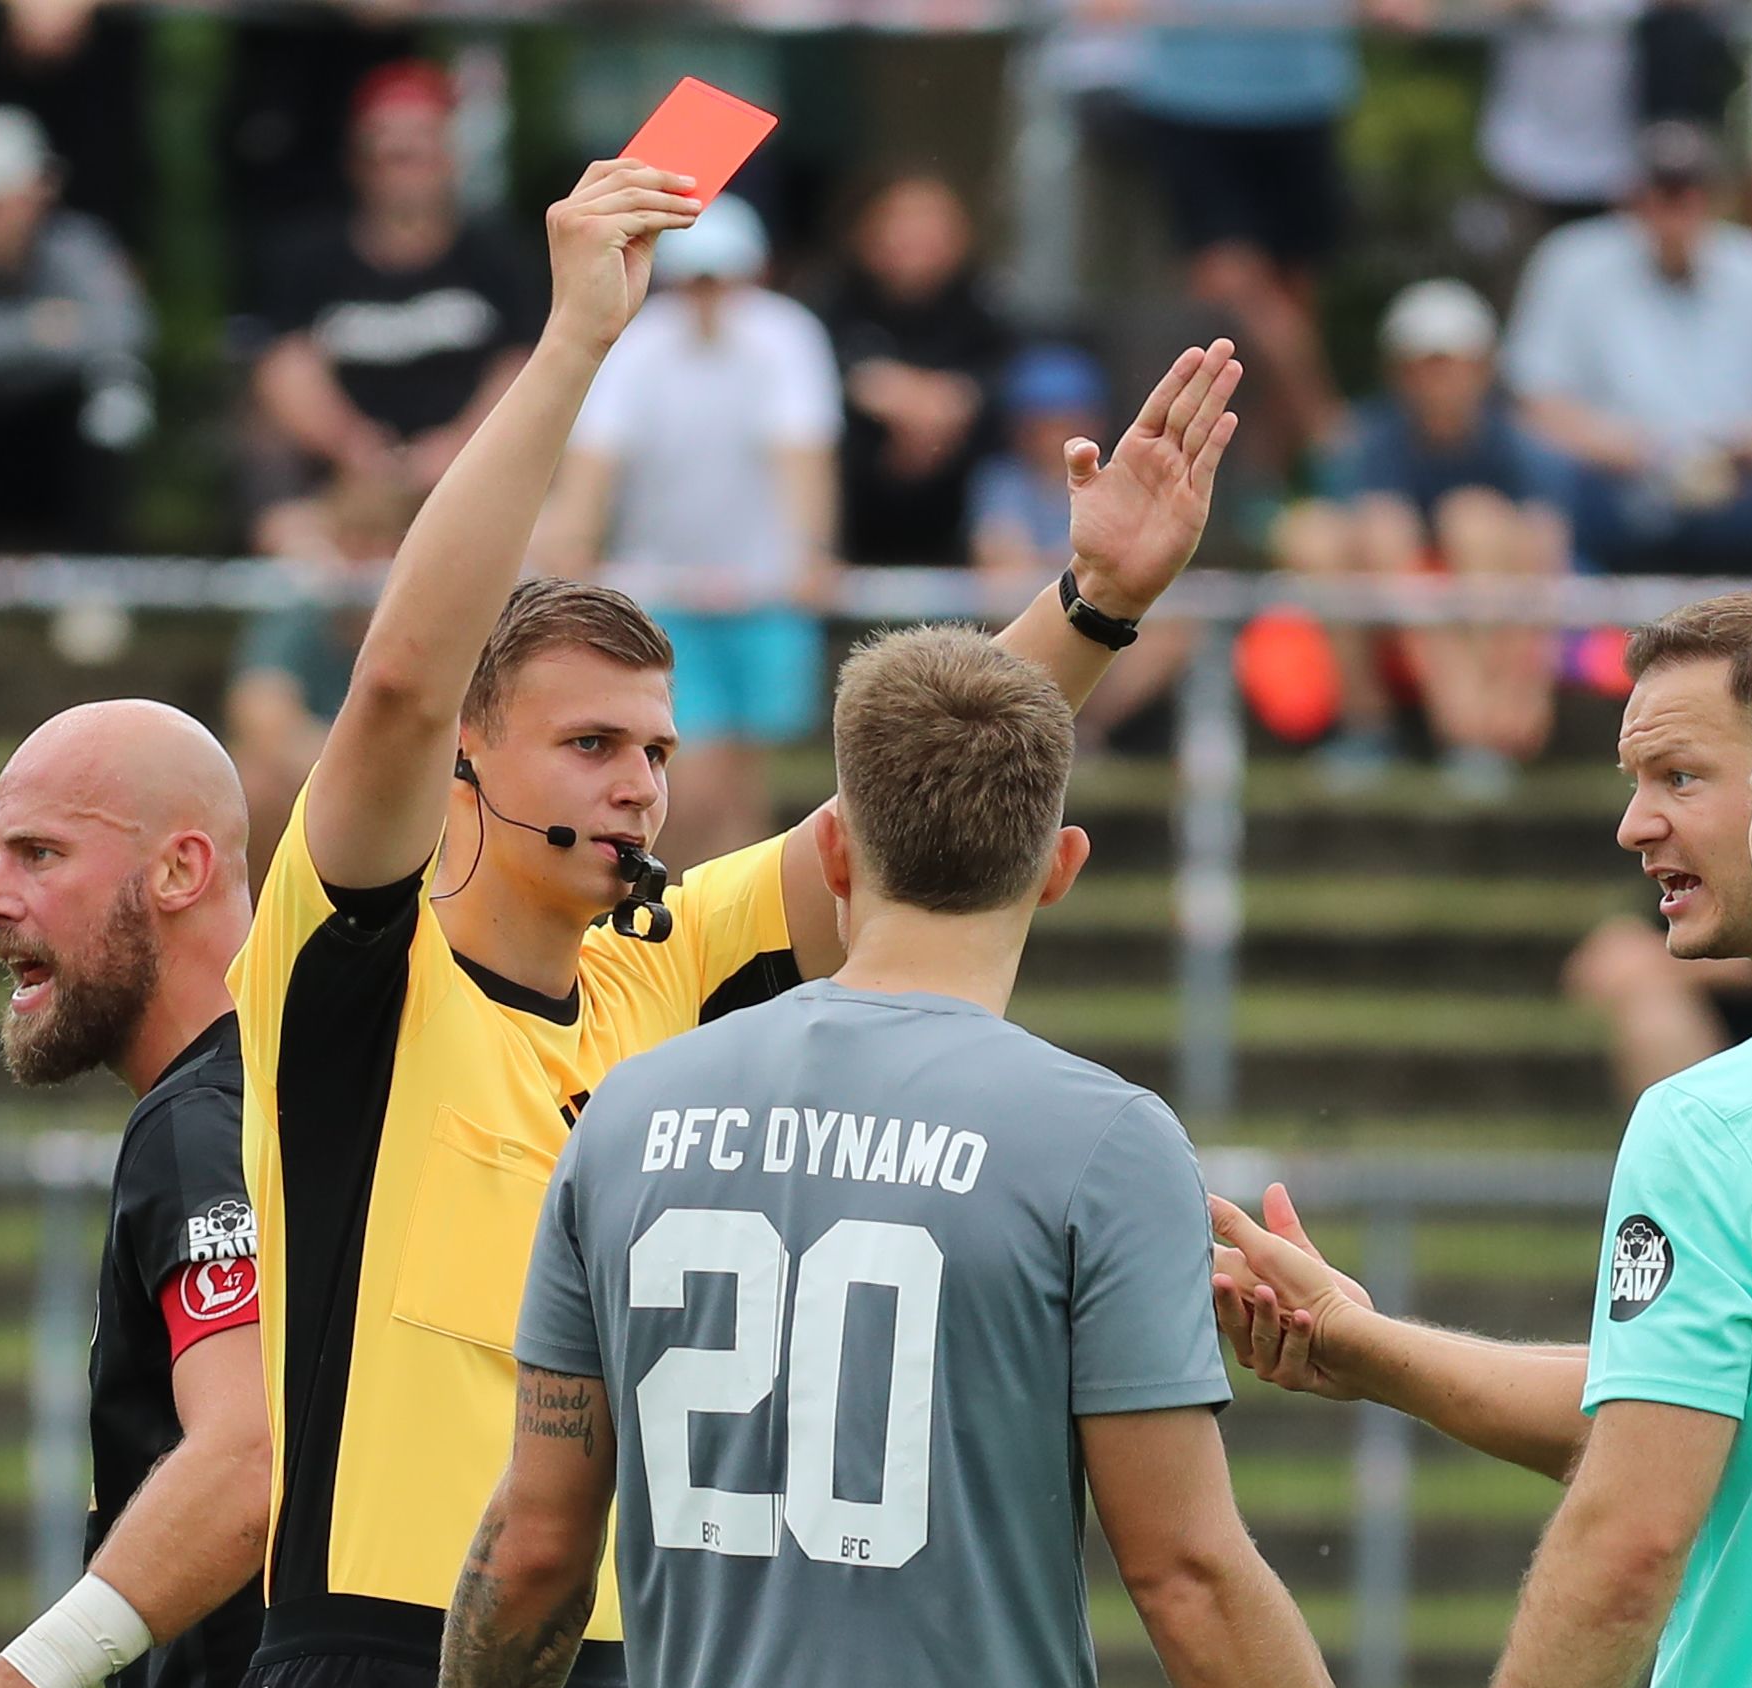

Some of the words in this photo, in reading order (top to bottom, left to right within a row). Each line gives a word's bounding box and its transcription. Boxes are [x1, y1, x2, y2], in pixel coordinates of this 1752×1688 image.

[641, 1107, 751, 1173] BFC
[762, 1107, 988, 1194] DYNAMO
[1611, 1268, 1665, 1301] AW
[629, 1208, 944, 1568] 20
[702, 1521, 722, 1546] BFC
[840, 1535, 871, 1561] BFC
